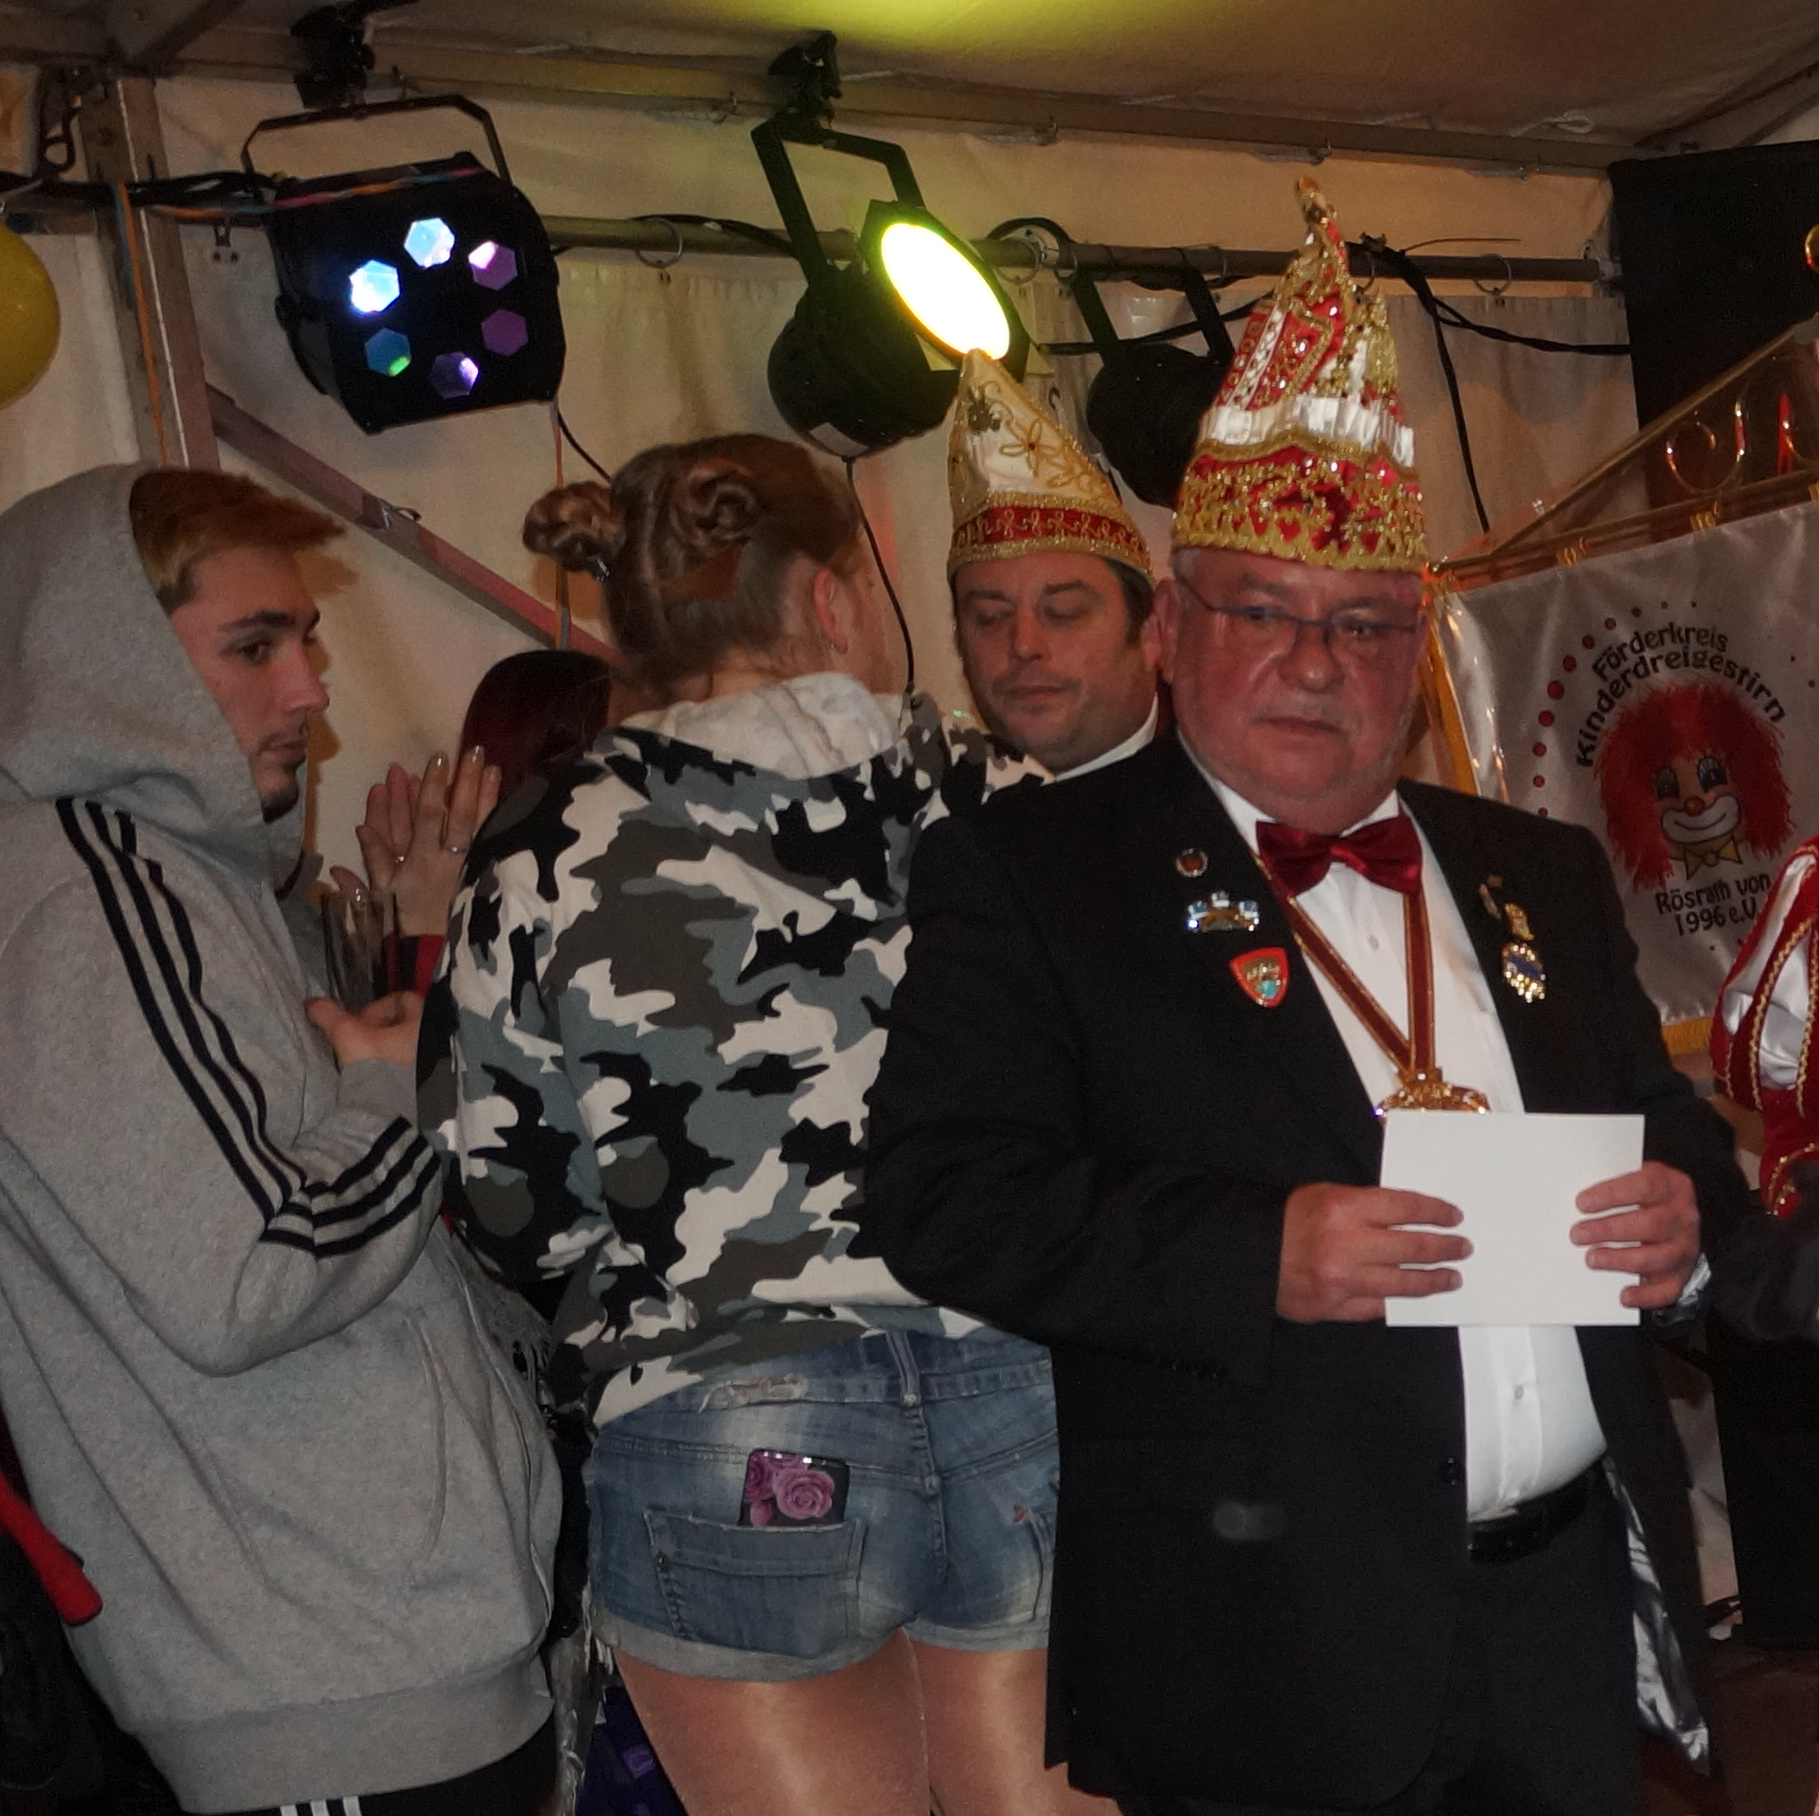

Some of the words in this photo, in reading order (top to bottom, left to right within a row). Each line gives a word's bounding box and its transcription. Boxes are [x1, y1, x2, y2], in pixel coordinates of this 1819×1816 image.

[1591, 622, 1729, 682] Förderkreis
[1576, 646, 1786, 767] Kinderdreigestirn
[1655, 879, 1731, 915] Rösrath
[1735, 873, 1771, 895] von
[1674, 906, 1726, 936] 1996
